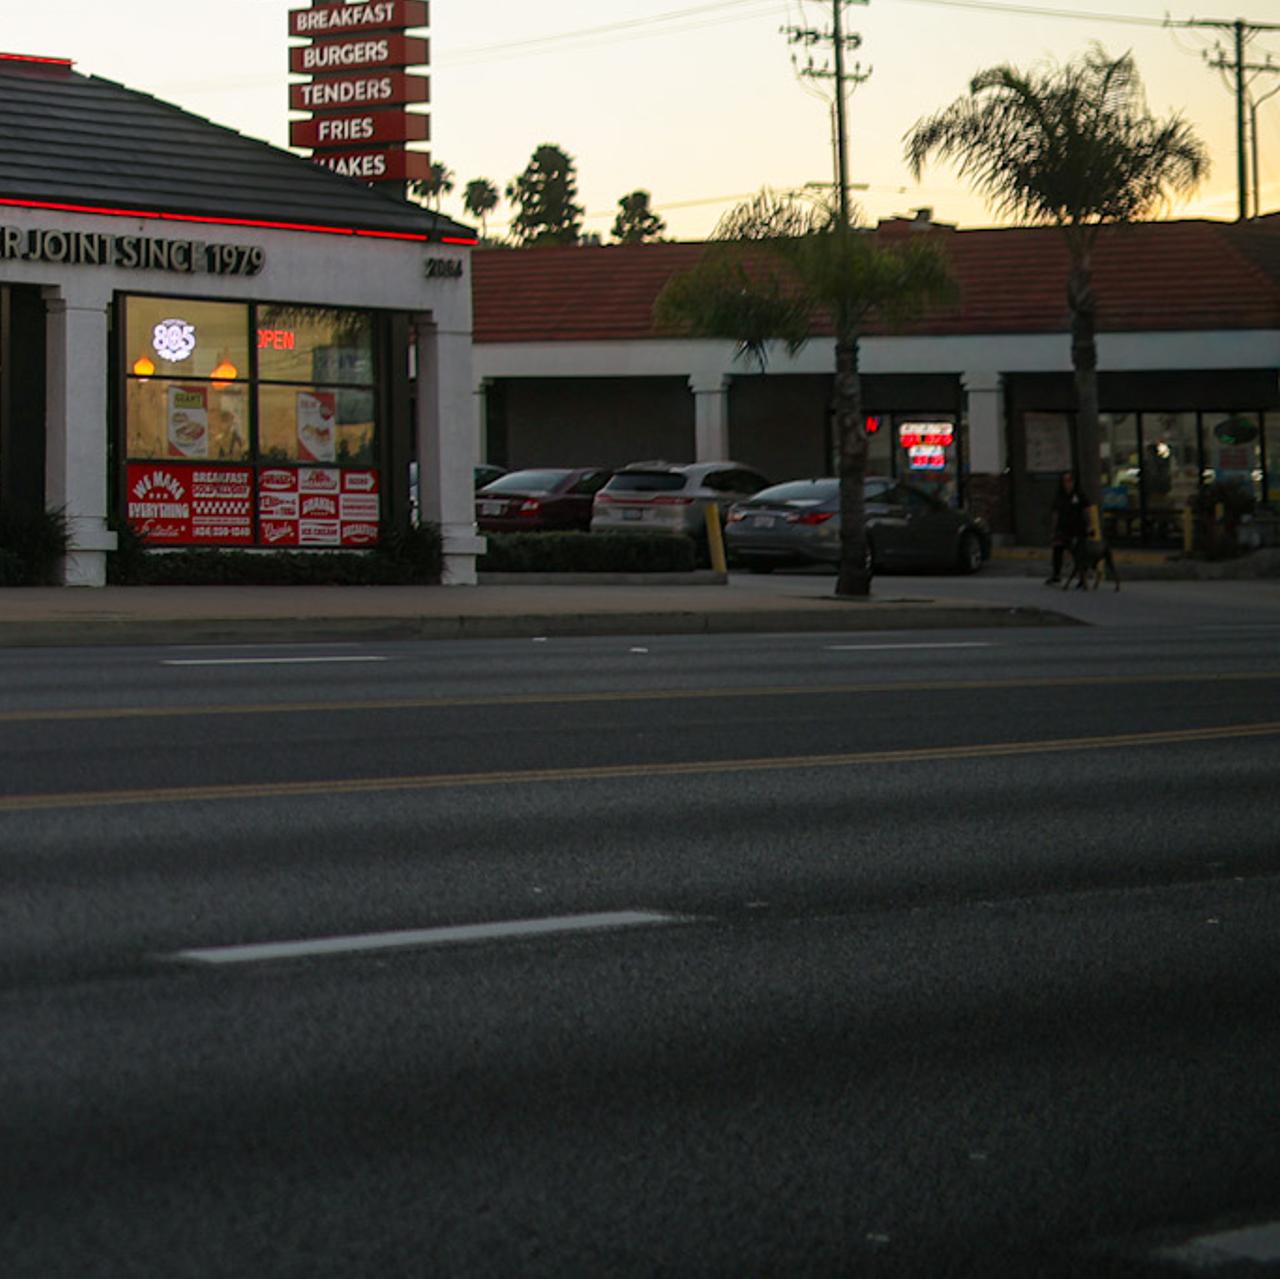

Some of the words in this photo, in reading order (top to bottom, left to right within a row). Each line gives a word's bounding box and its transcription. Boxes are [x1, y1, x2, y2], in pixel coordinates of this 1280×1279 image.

[297, 2, 394, 32] BREAKFAST
[304, 40, 388, 68] BURGERS
[301, 77, 392, 105] TENDERS
[319, 117, 374, 141] FRIES
[314, 154, 386, 177] AKES
[27, 229, 116, 267] JOINT
[115, 234, 208, 274] SINCE
[209, 245, 267, 276] 1979
[132, 474, 152, 500] WE
[152, 470, 186, 501] MAKE
[192, 471, 249, 483] BREAKFAST
[128, 502, 190, 518] EVERYTHING
